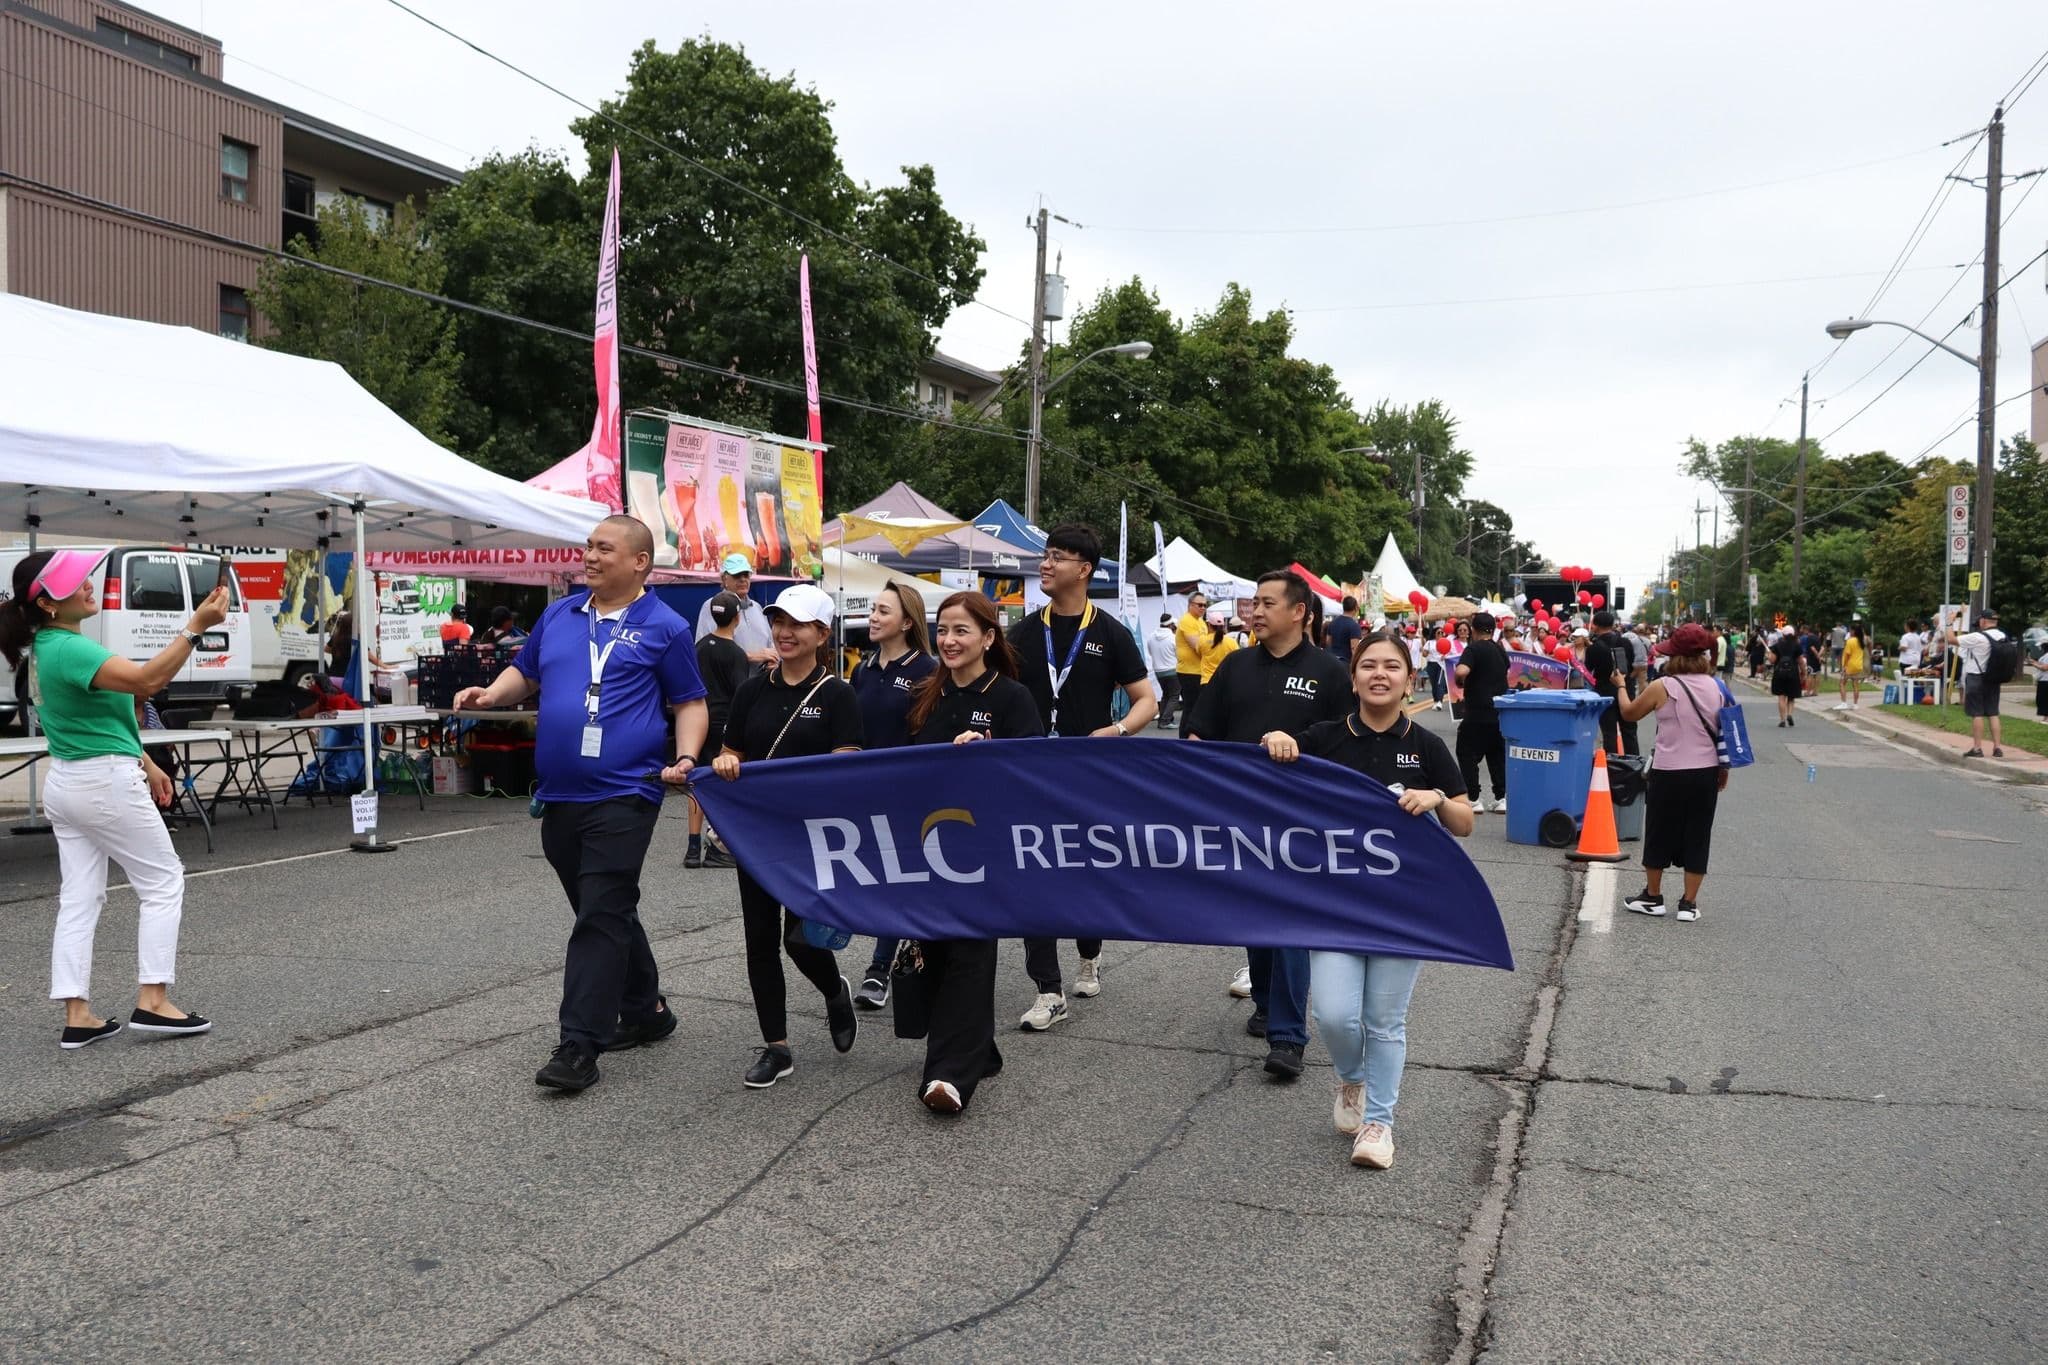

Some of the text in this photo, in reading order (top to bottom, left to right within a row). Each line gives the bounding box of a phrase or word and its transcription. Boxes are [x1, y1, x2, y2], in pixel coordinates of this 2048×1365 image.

[148, 555, 170, 564] Need
[534, 548, 585, 563] HOUS
[1085, 641, 1104, 653] RLC
[894, 676, 912, 688] RLC
[1285, 676, 1319, 694] RLC
[801, 706, 822, 715] RLC
[971, 711, 992, 722] RLC
[1396, 753, 1420, 764] RLC
[1521, 748, 1555, 761] EVENTS
[804, 808, 1401, 891] RLC RESIDENCES
